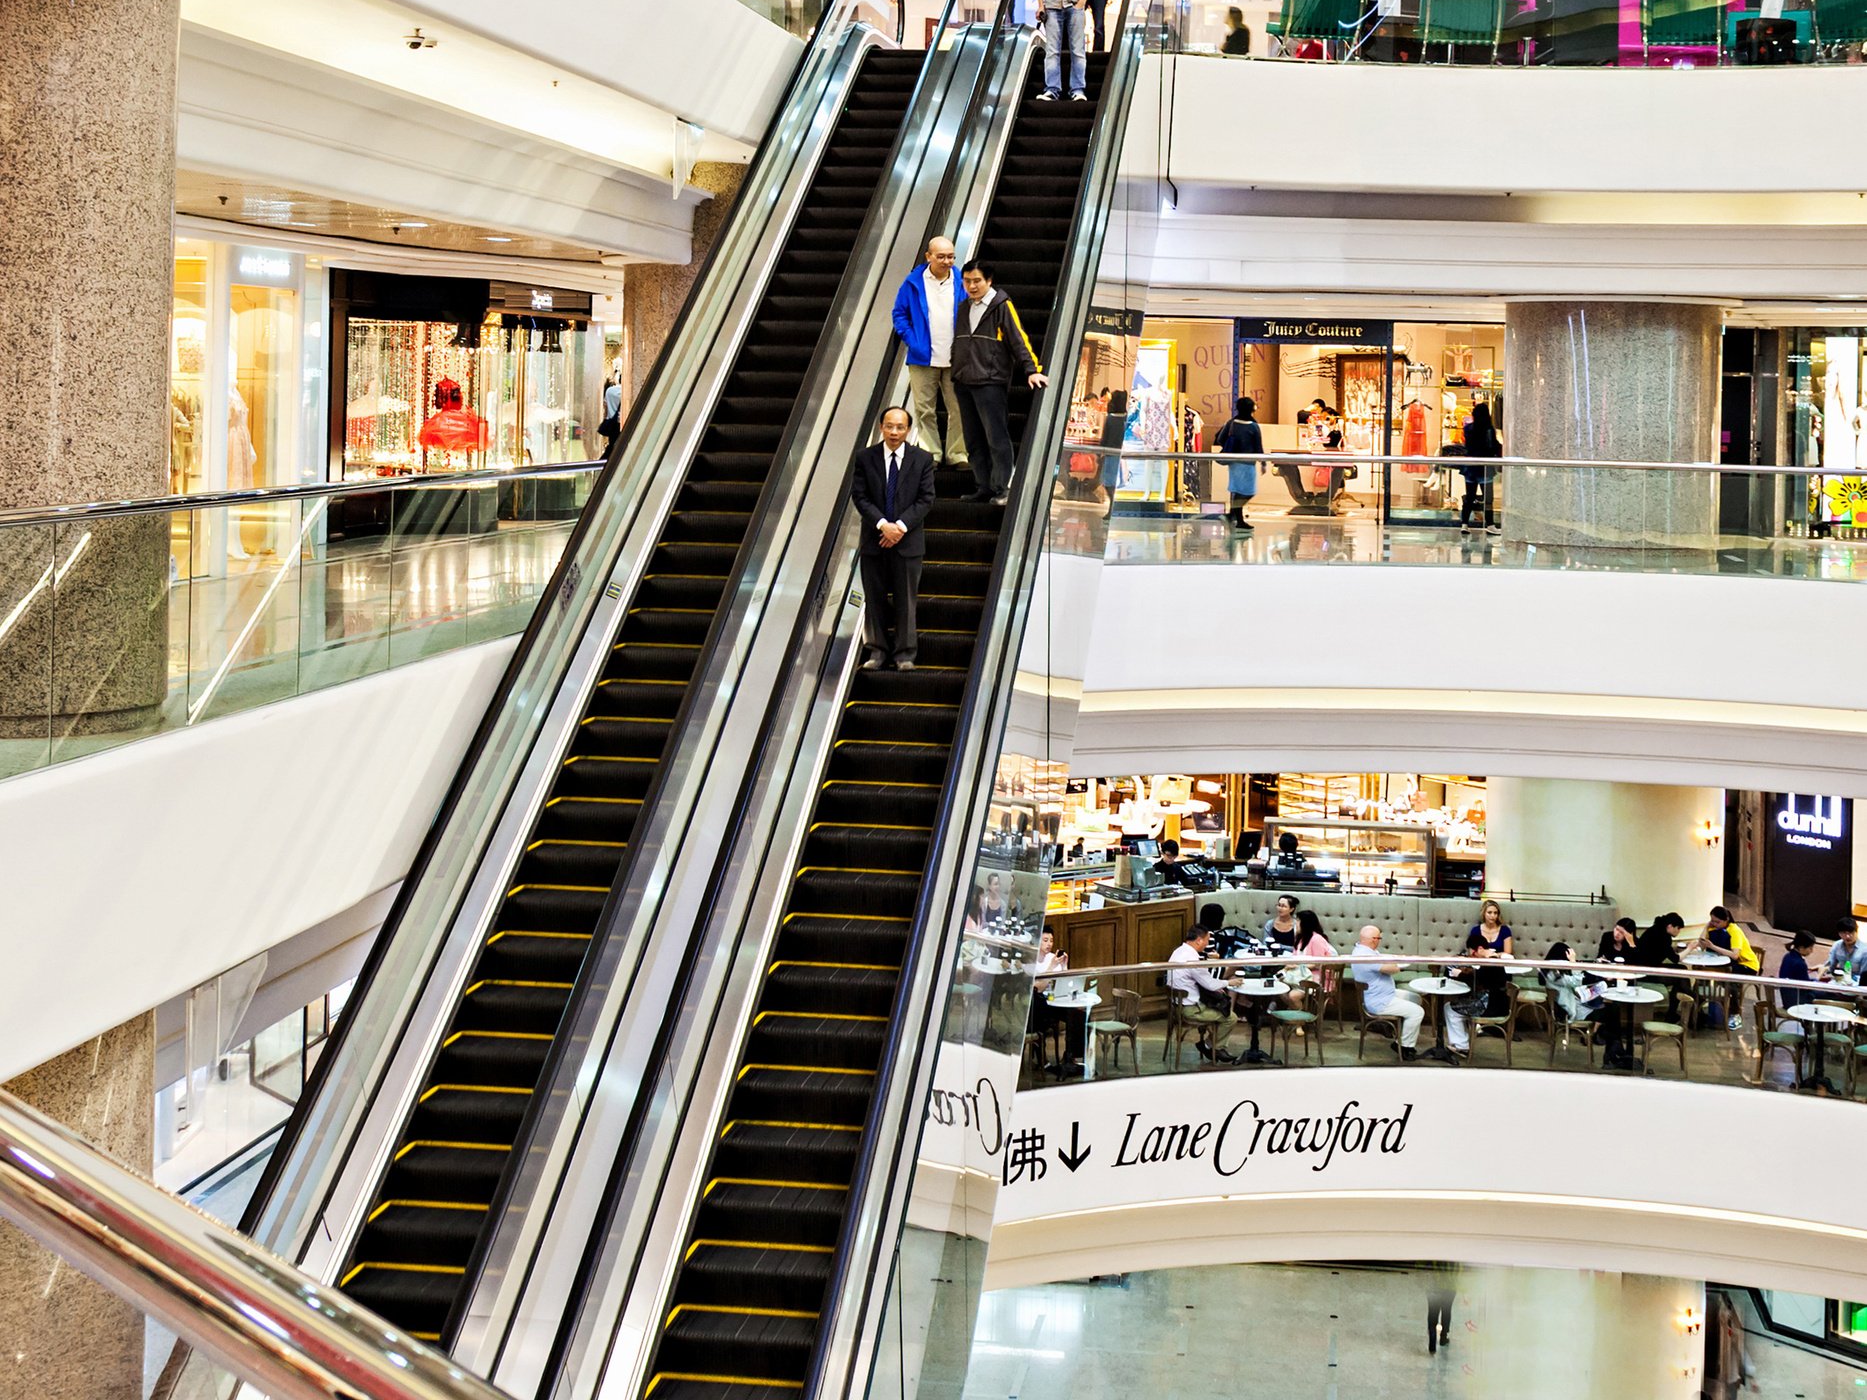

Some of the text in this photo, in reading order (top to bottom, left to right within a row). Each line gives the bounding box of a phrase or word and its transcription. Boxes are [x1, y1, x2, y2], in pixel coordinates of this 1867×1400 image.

[1263, 320, 1364, 338] Juicy Couture
[1002, 1128, 1048, 1187] 佛
[1111, 1099, 1414, 1177] Lane Crawford
